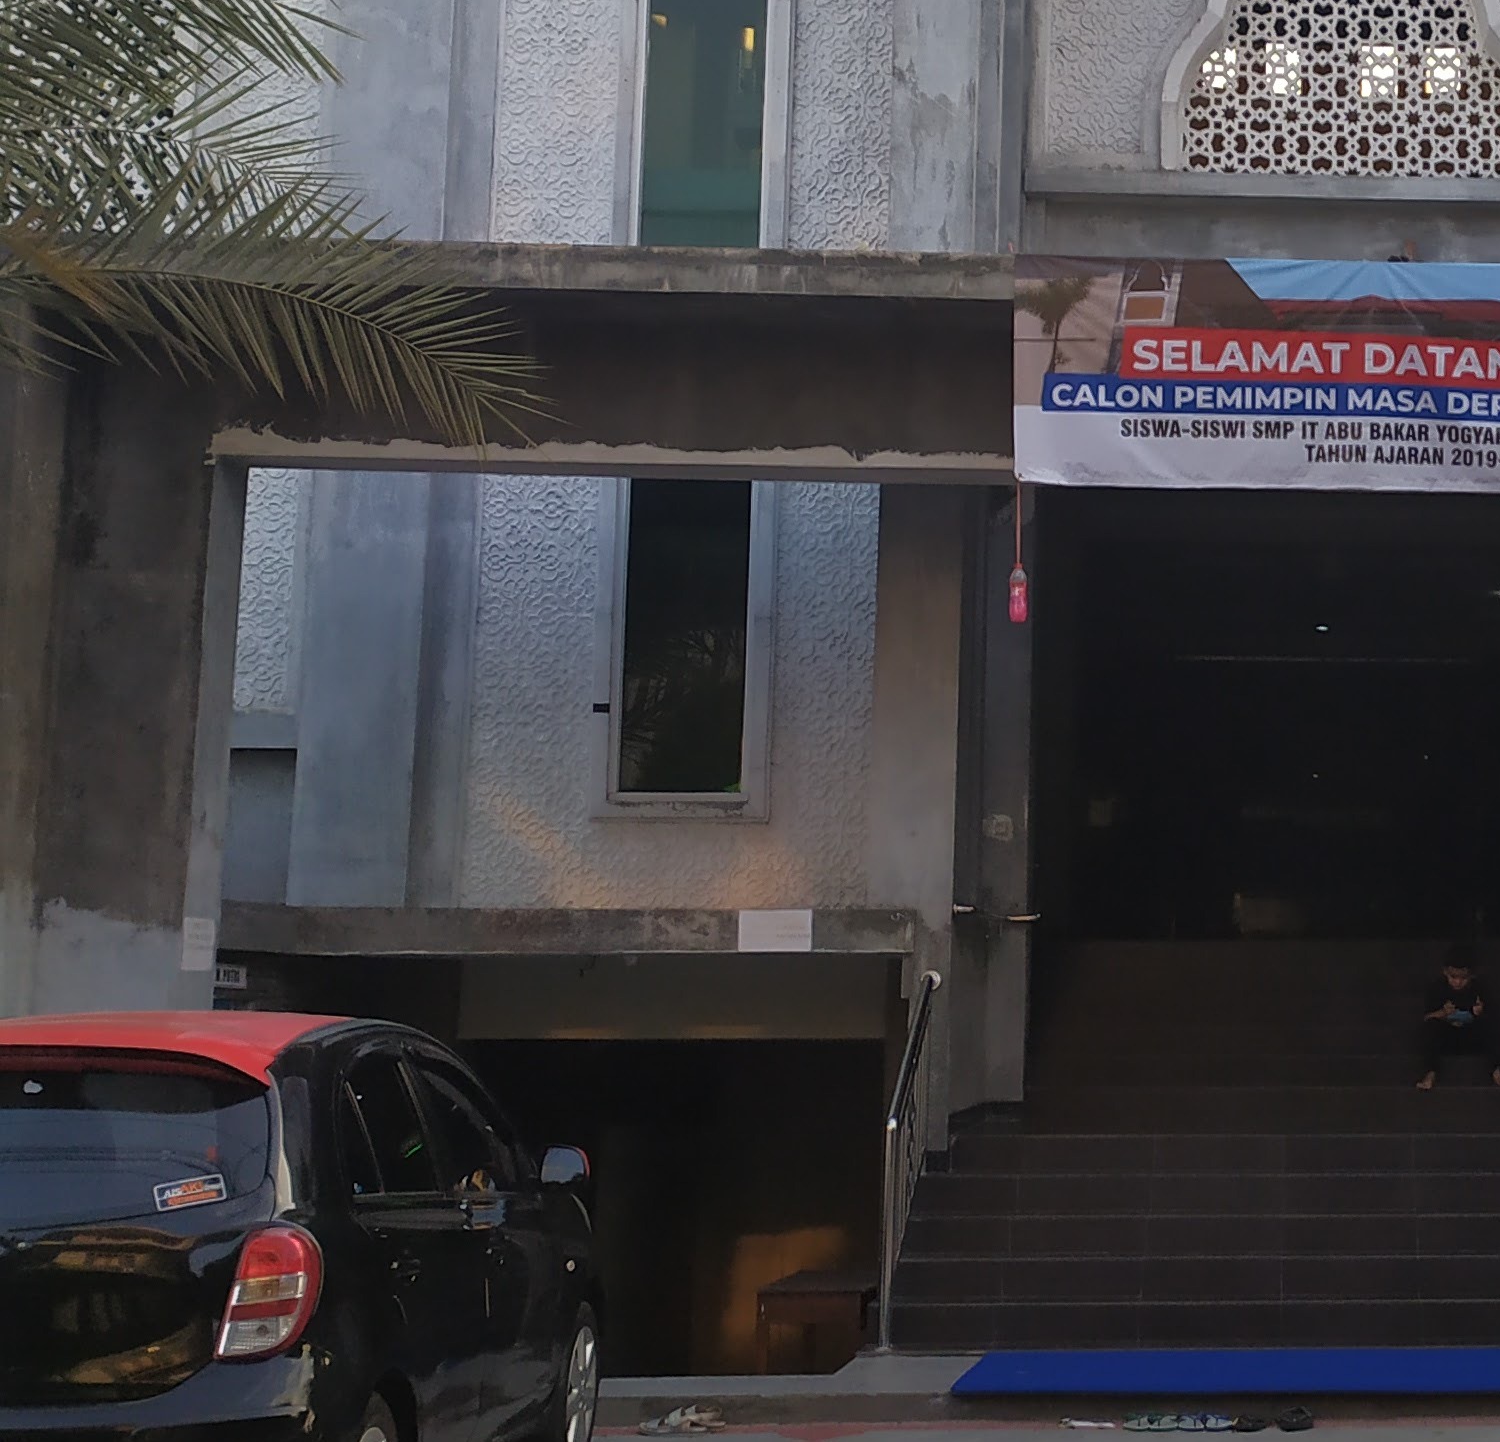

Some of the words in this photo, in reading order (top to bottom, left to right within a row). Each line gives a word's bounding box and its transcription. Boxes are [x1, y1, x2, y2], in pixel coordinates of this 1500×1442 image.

[1132, 338, 1350, 374] SELAMAT
[1051, 383, 1163, 408] CALON
[1174, 385, 1337, 410] PEMIMPIN
[1348, 388, 1437, 413] MASA
[1120, 418, 1246, 439] SISWA-SISWI
[1252, 420, 1295, 440] SMP
[1301, 421, 1319, 440] IT
[1325, 421, 1362, 440] ABU
[1369, 422, 1429, 442] BAKAR
[1304, 443, 1367, 463] TAHUN
[1373, 445, 1444, 466] AJARAN
